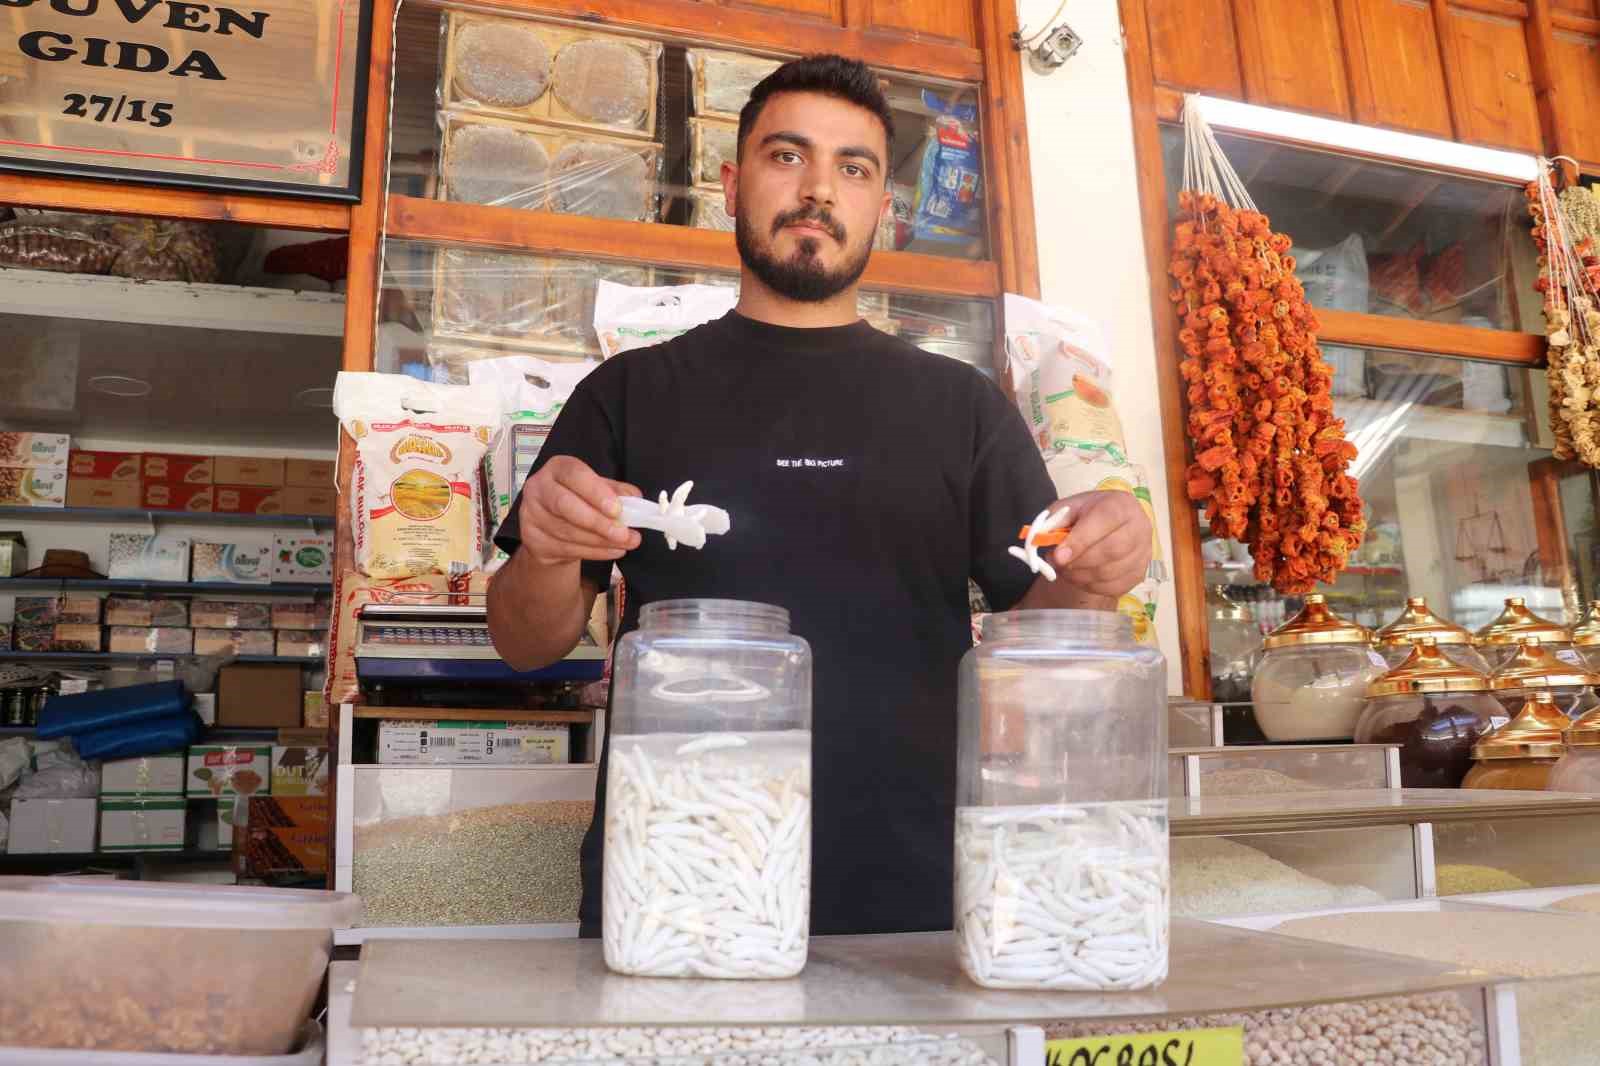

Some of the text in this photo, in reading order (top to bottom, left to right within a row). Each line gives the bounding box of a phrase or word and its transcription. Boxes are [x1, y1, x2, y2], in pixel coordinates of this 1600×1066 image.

[0, 0, 271, 39] UVEN
[18, 31, 227, 81] GIDA
[62, 94, 174, 127] 27/15
